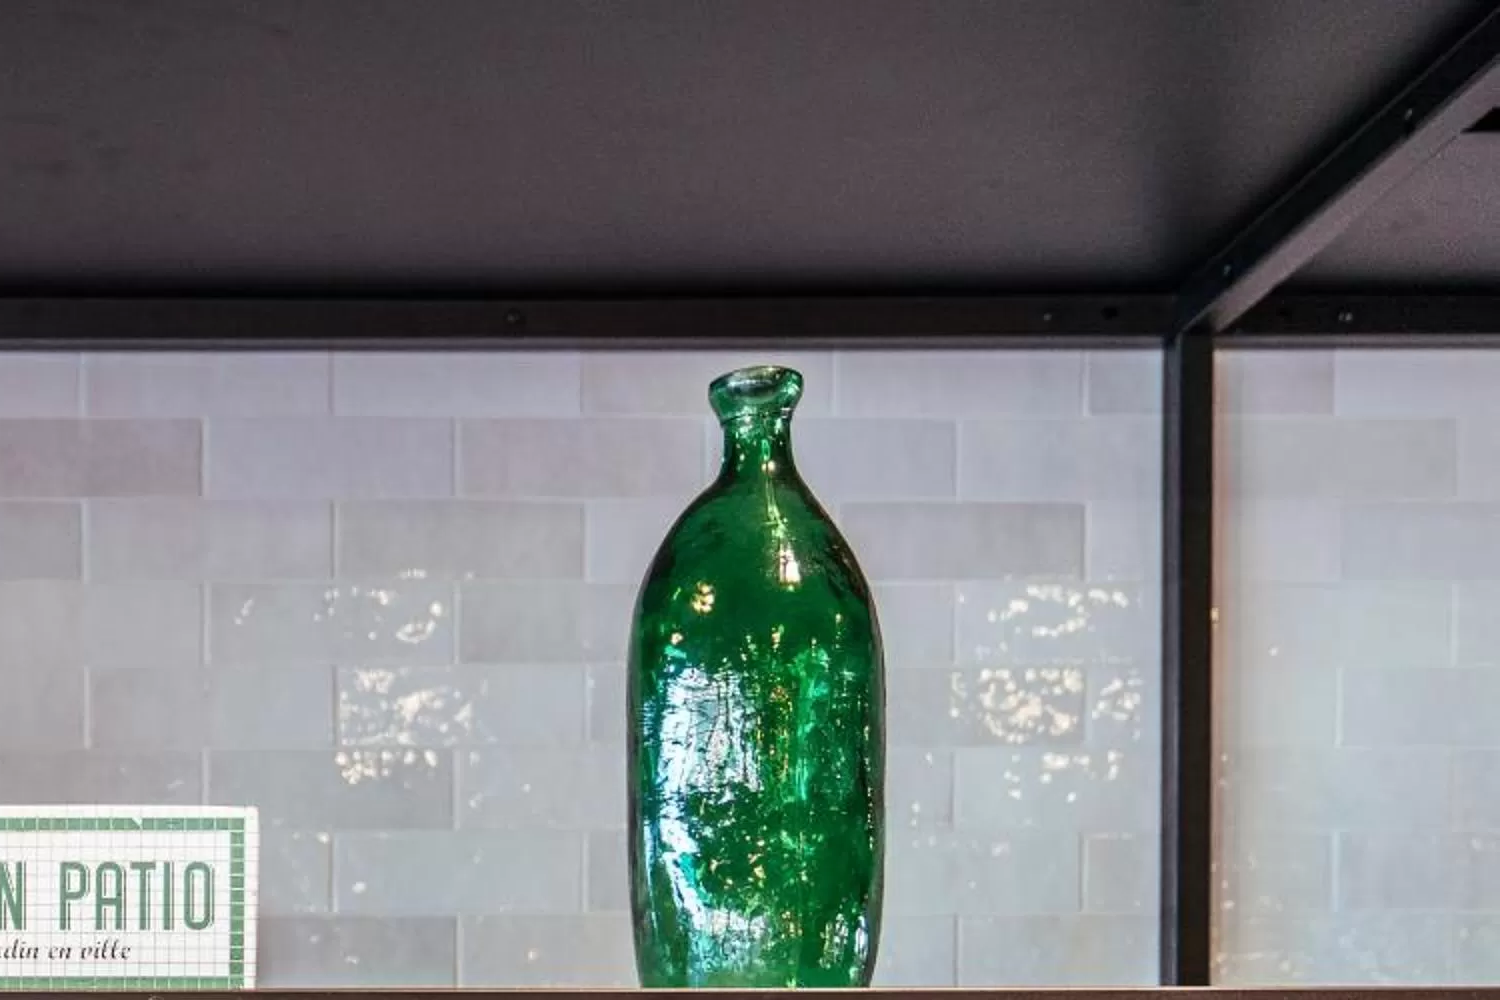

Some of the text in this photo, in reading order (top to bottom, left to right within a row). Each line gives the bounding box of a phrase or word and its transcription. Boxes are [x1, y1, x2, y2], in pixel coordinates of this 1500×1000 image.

[58, 860, 216, 931] PATIO
[48, 945, 72, 960] en
[79, 938, 131, 960] ville
